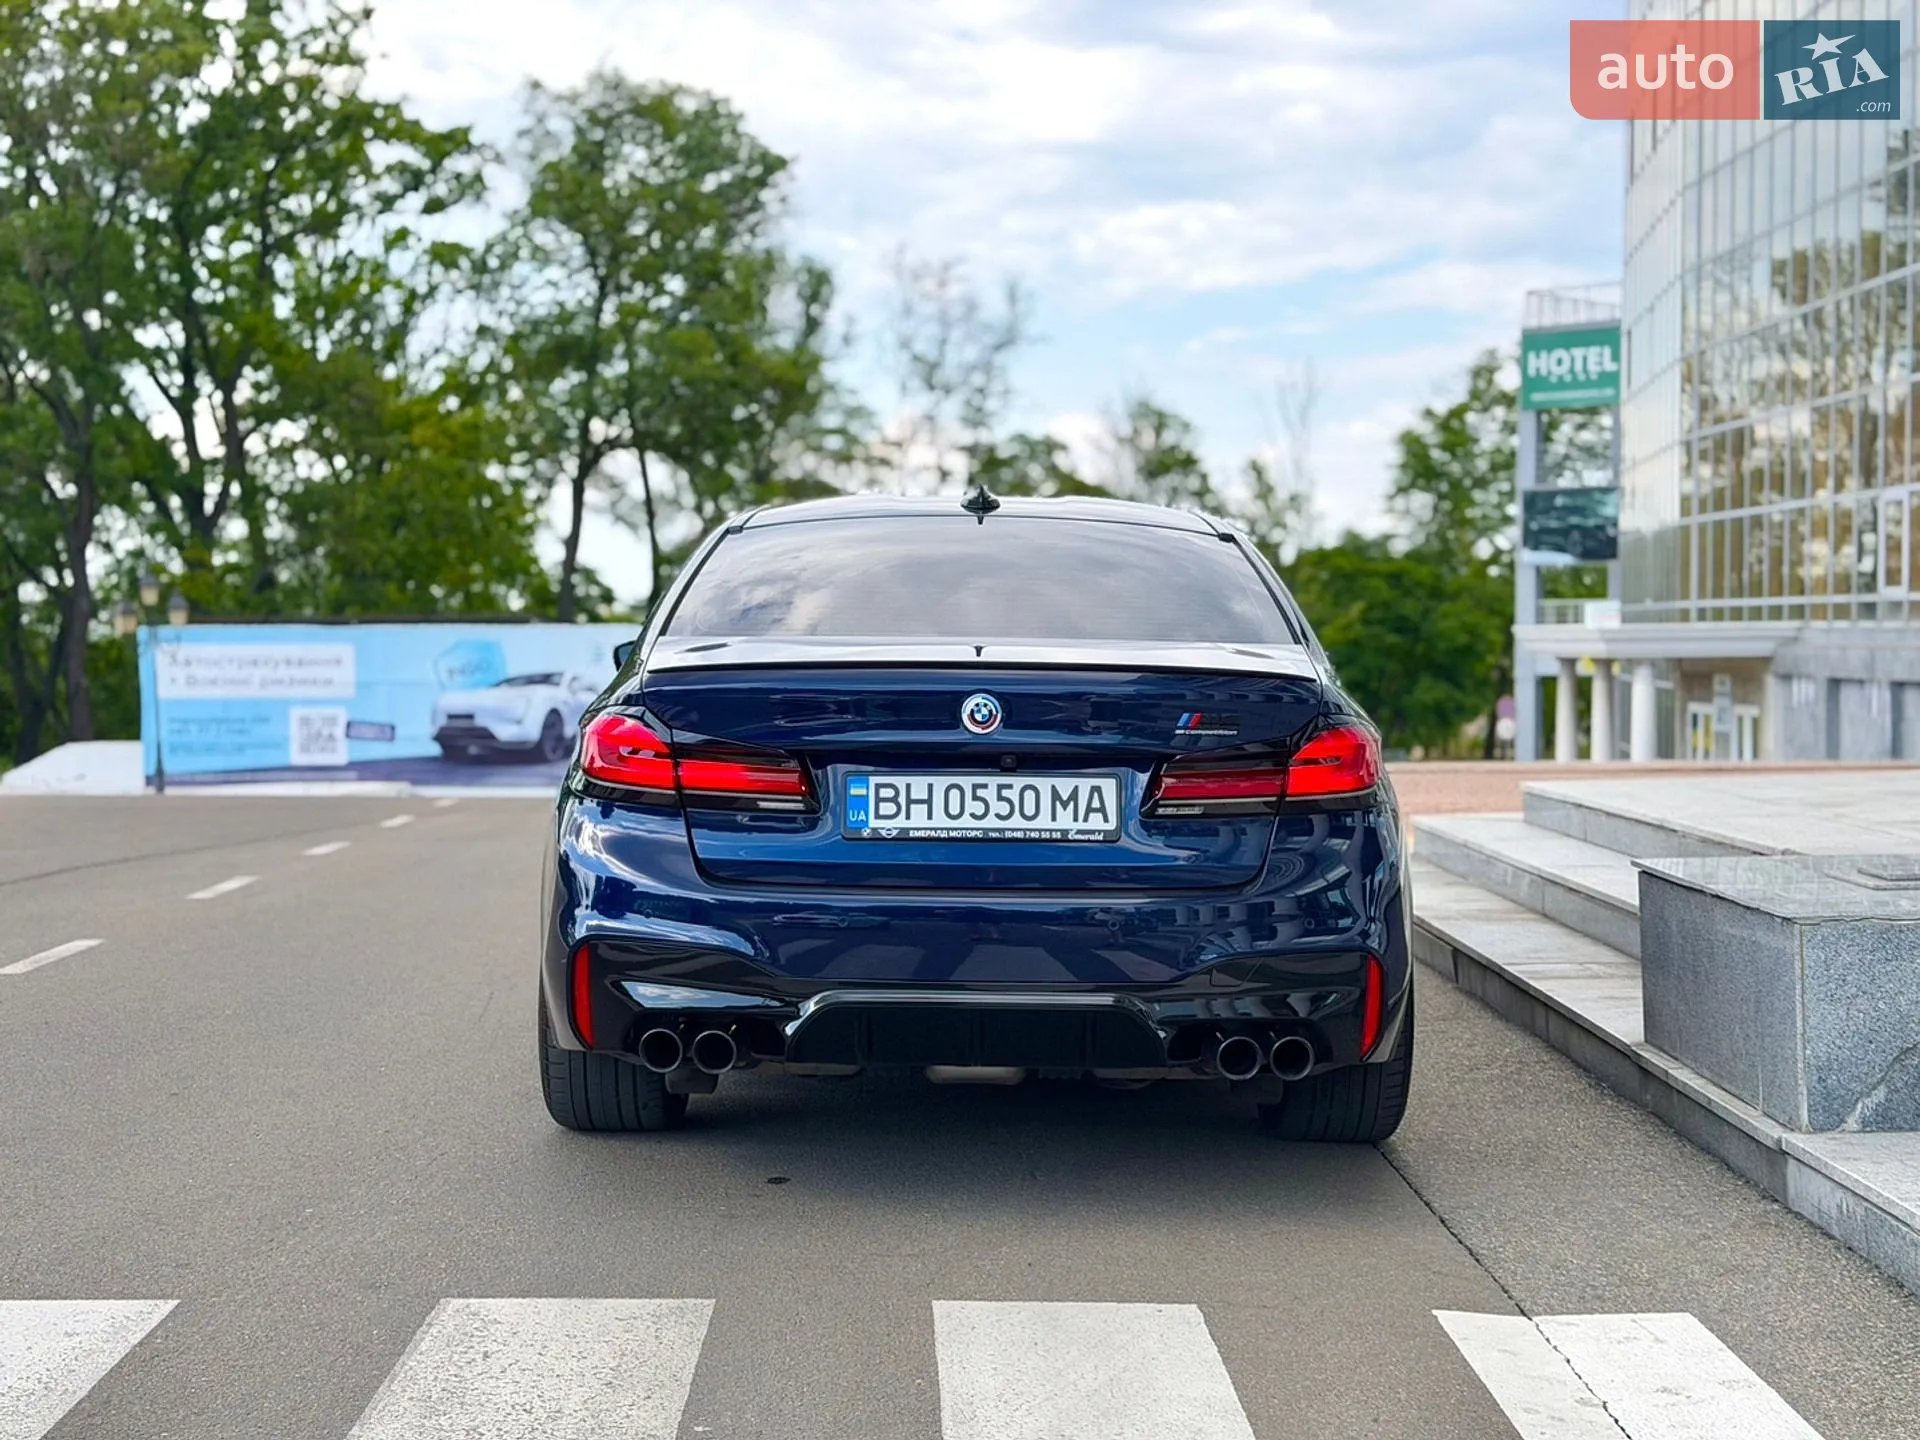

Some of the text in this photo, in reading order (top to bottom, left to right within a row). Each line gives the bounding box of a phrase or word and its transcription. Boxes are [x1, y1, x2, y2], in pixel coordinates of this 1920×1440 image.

[1527, 344, 1619, 379] HOTEL
[874, 782, 1110, 824] BH 0550 MA
[849, 810, 867, 822] UA
[909, 830, 948, 838] ЕМЕРАЛД
[949, 830, 983, 838] МОТОРС
[1068, 828, 1104, 840] Emerald
